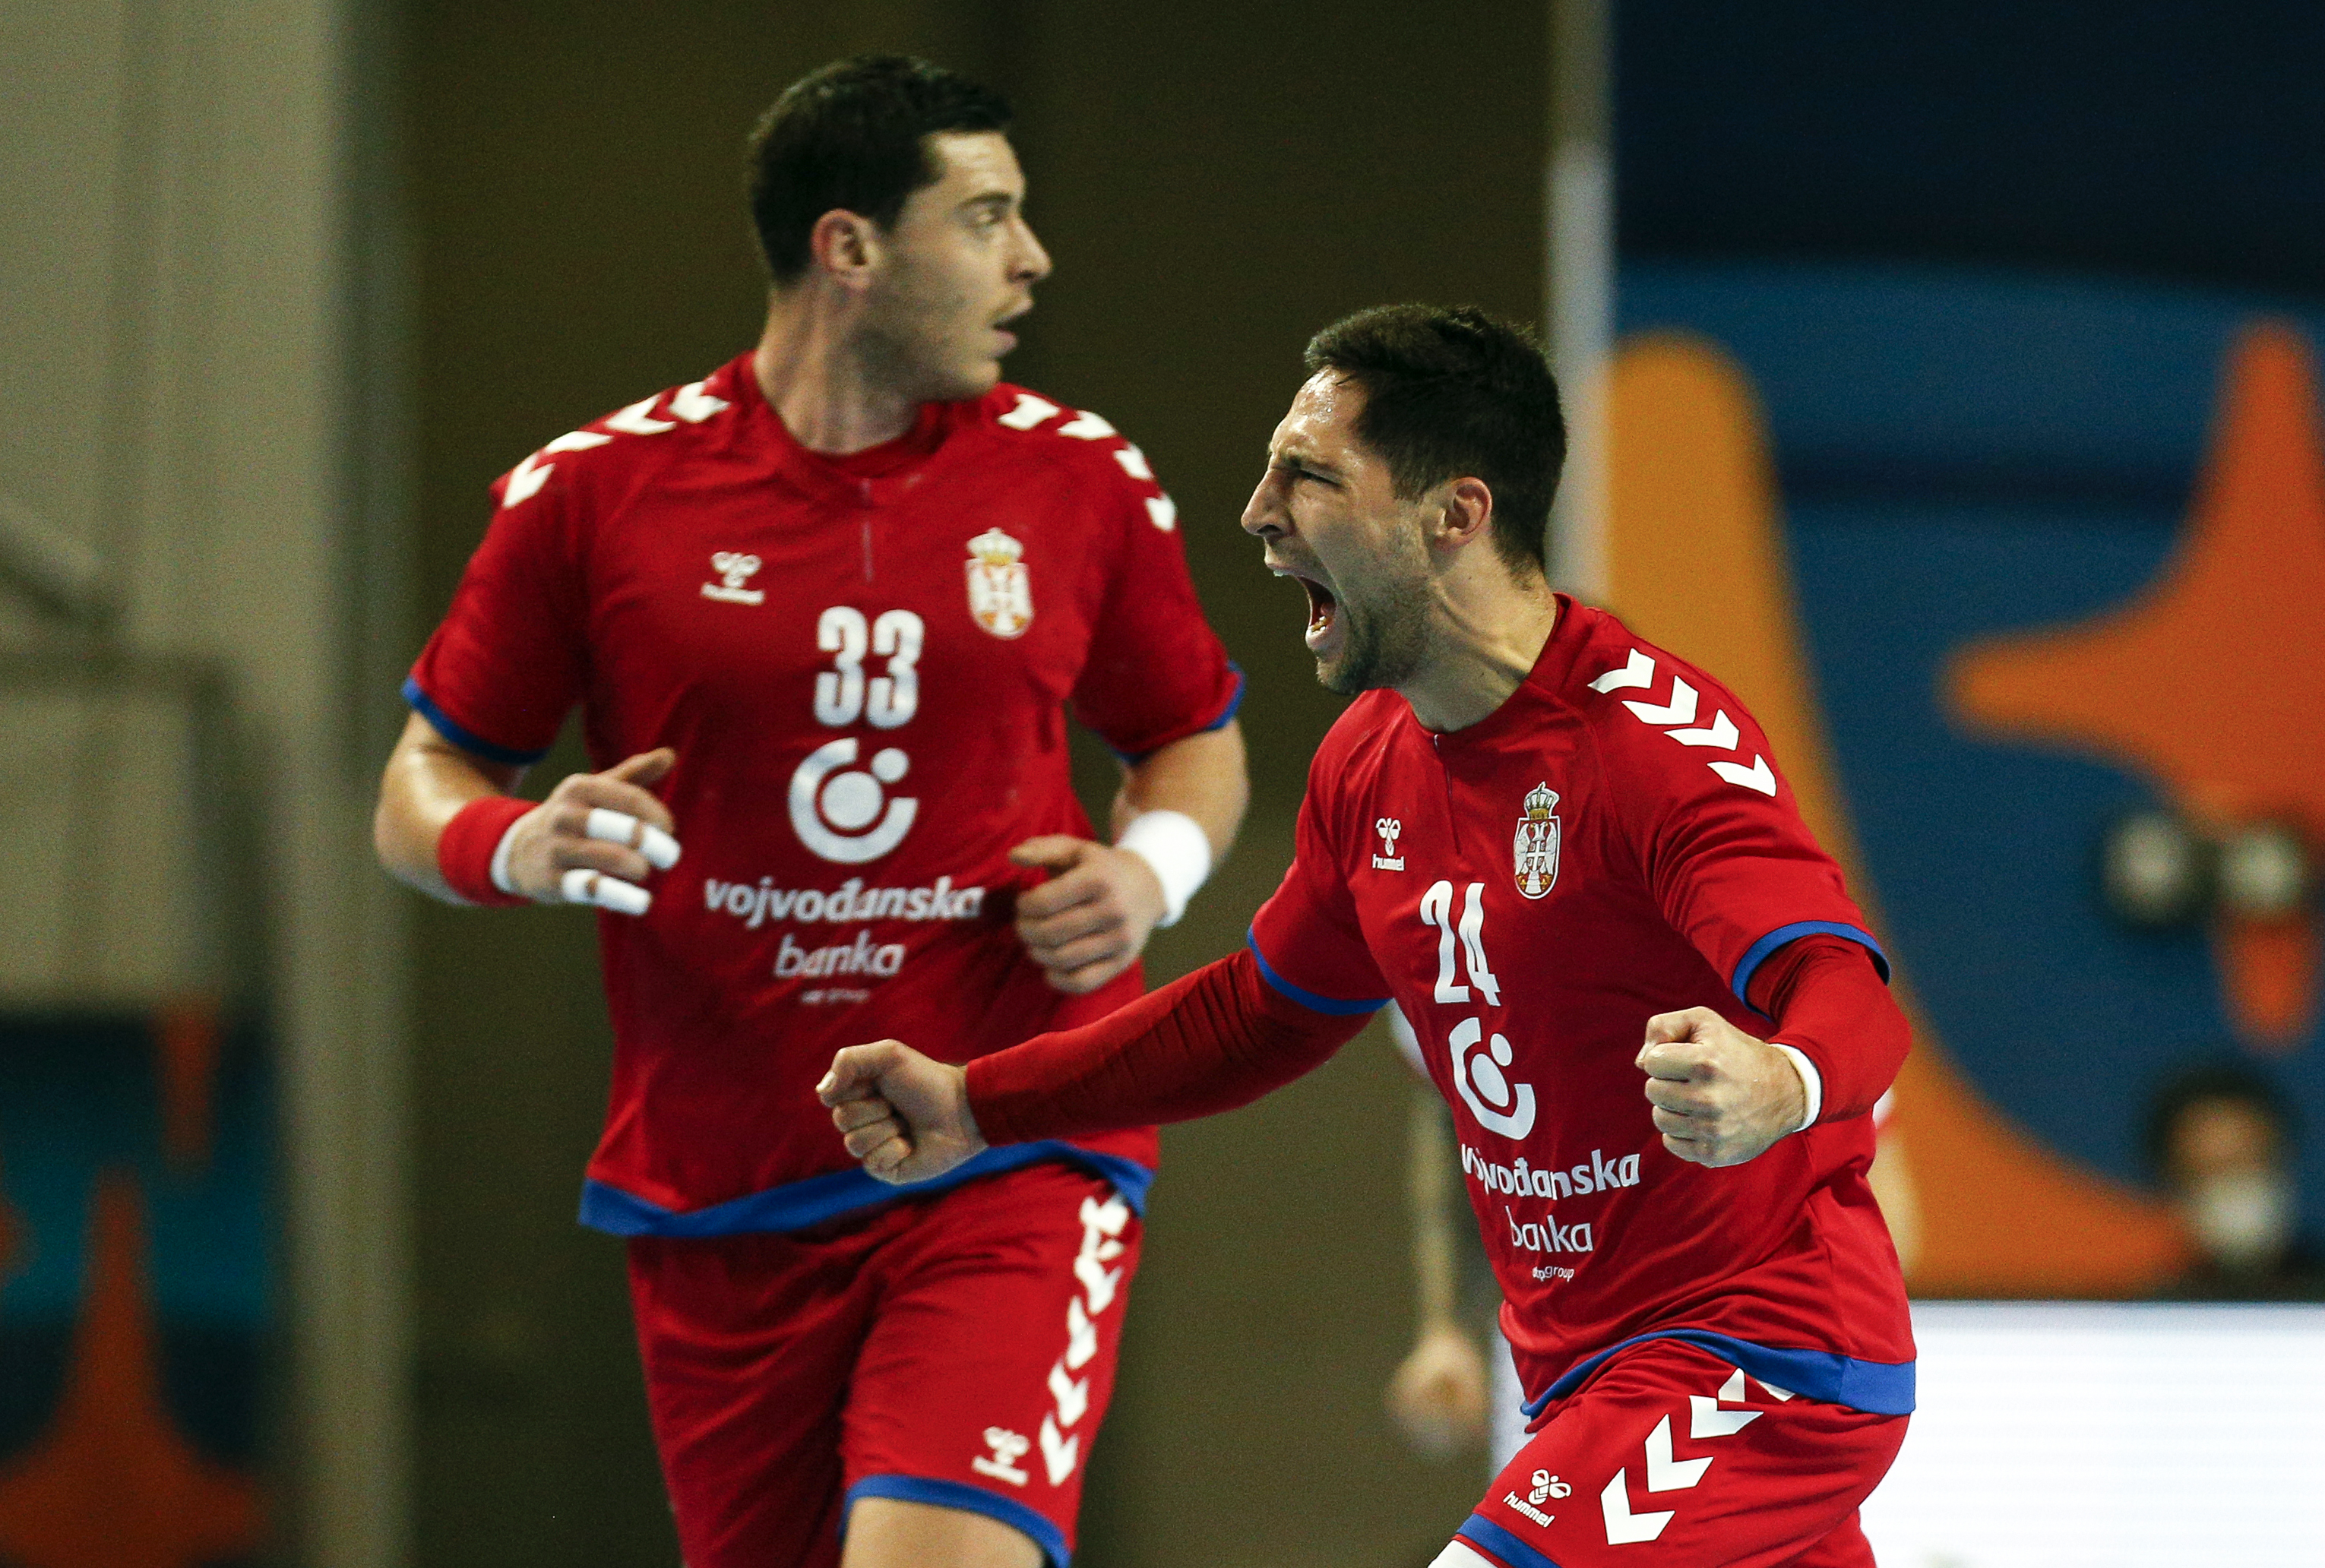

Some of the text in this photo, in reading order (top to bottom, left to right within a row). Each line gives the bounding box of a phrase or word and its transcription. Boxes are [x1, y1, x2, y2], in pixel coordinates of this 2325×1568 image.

[814, 606, 924, 729] 33
[774, 929, 906, 978] banka
[1419, 880, 1501, 1007] 24
[1503, 1491, 1555, 1528] hummel
